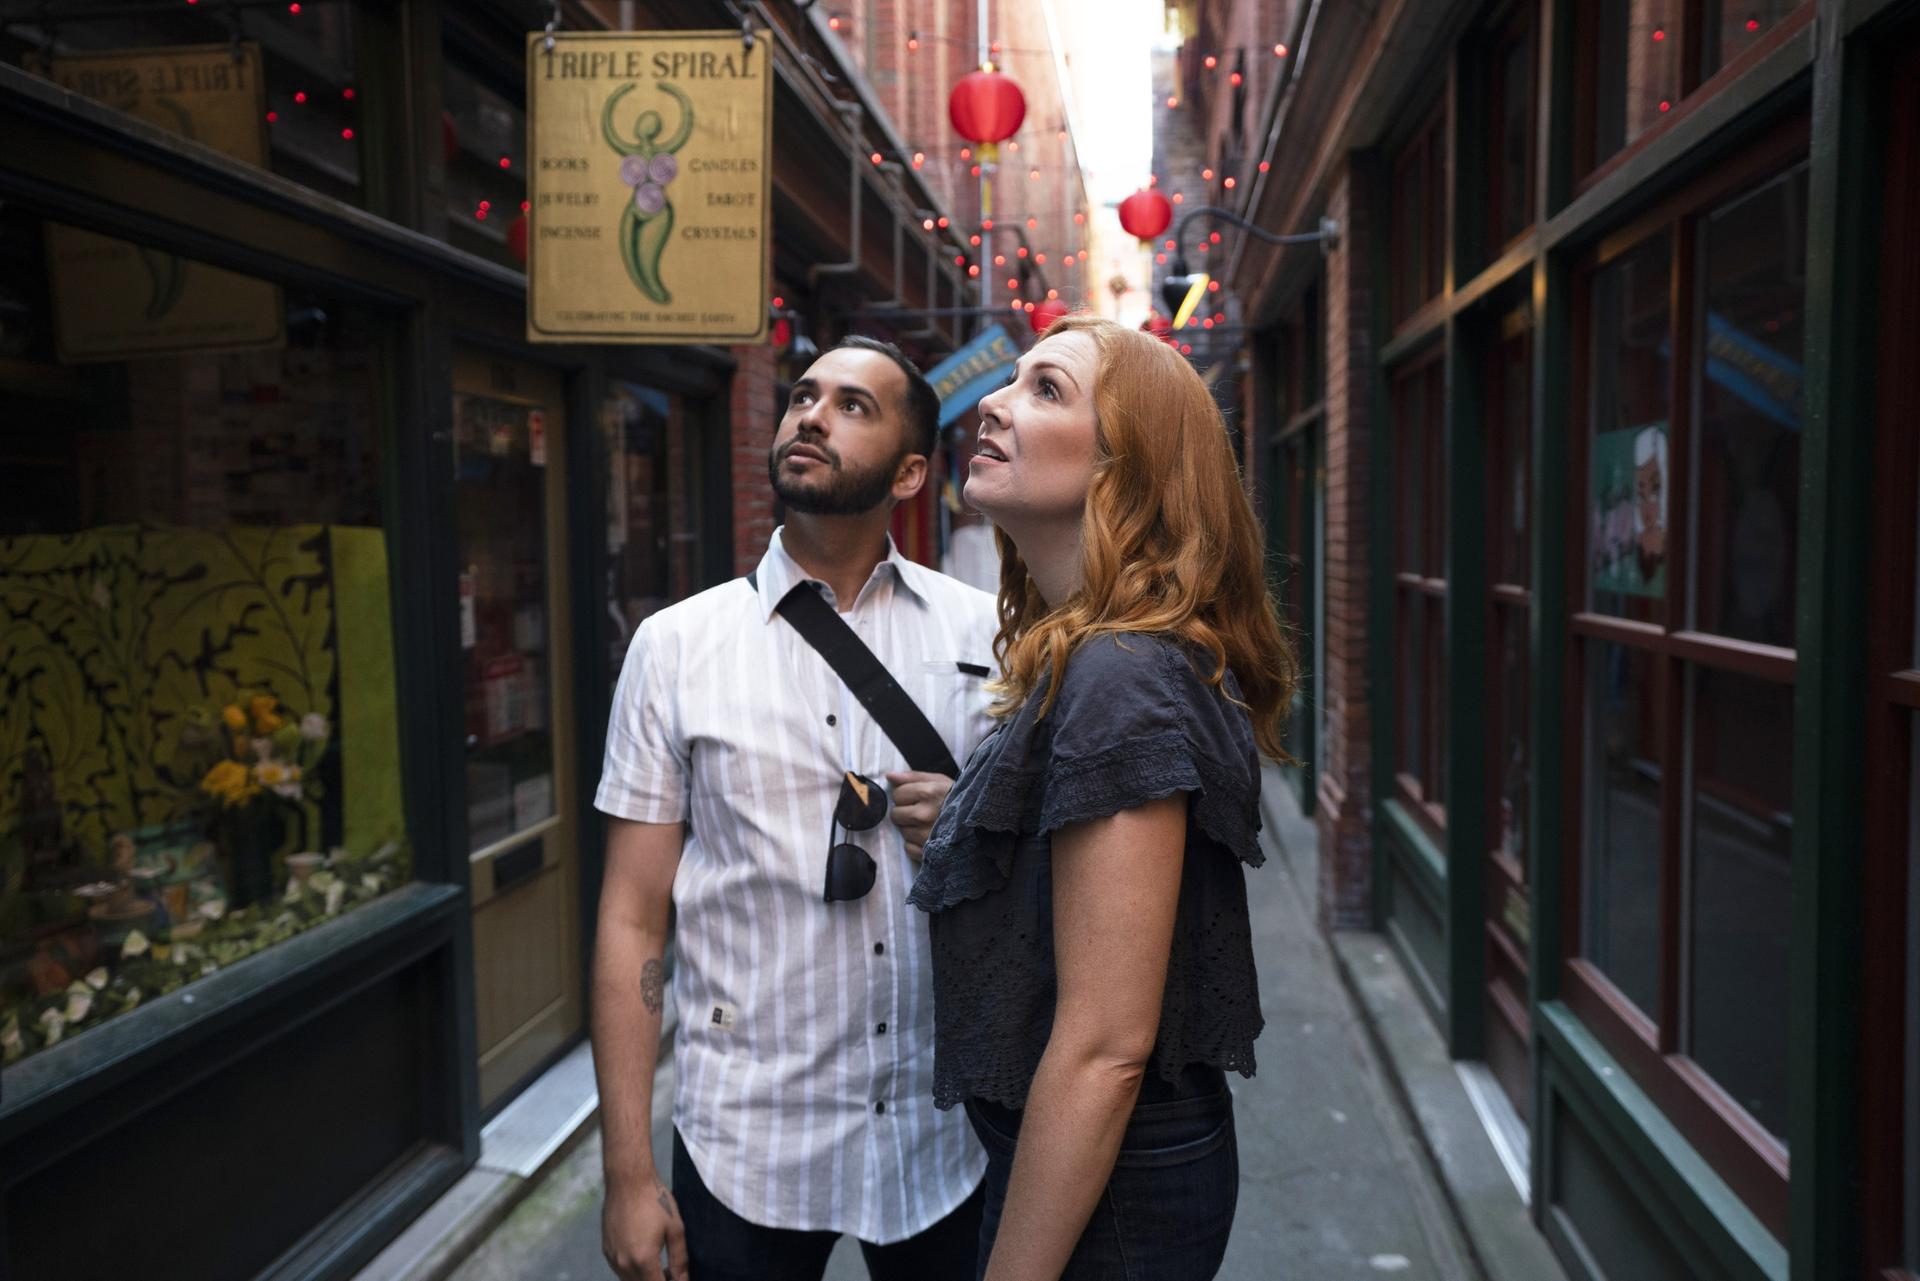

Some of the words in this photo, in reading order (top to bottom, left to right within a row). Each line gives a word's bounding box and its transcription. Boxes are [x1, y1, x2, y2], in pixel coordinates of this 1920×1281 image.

[541, 50, 643, 79] TRIPLE
[651, 51, 758, 79] SPIRAL
[540, 158, 590, 171] BOOKS
[688, 158, 758, 173] CANDLES
[539, 192, 599, 207] JEWELRY
[707, 192, 756, 207] TAROT
[540, 226, 601, 240] INCENSE
[681, 226, 758, 240] CRYSTALS
